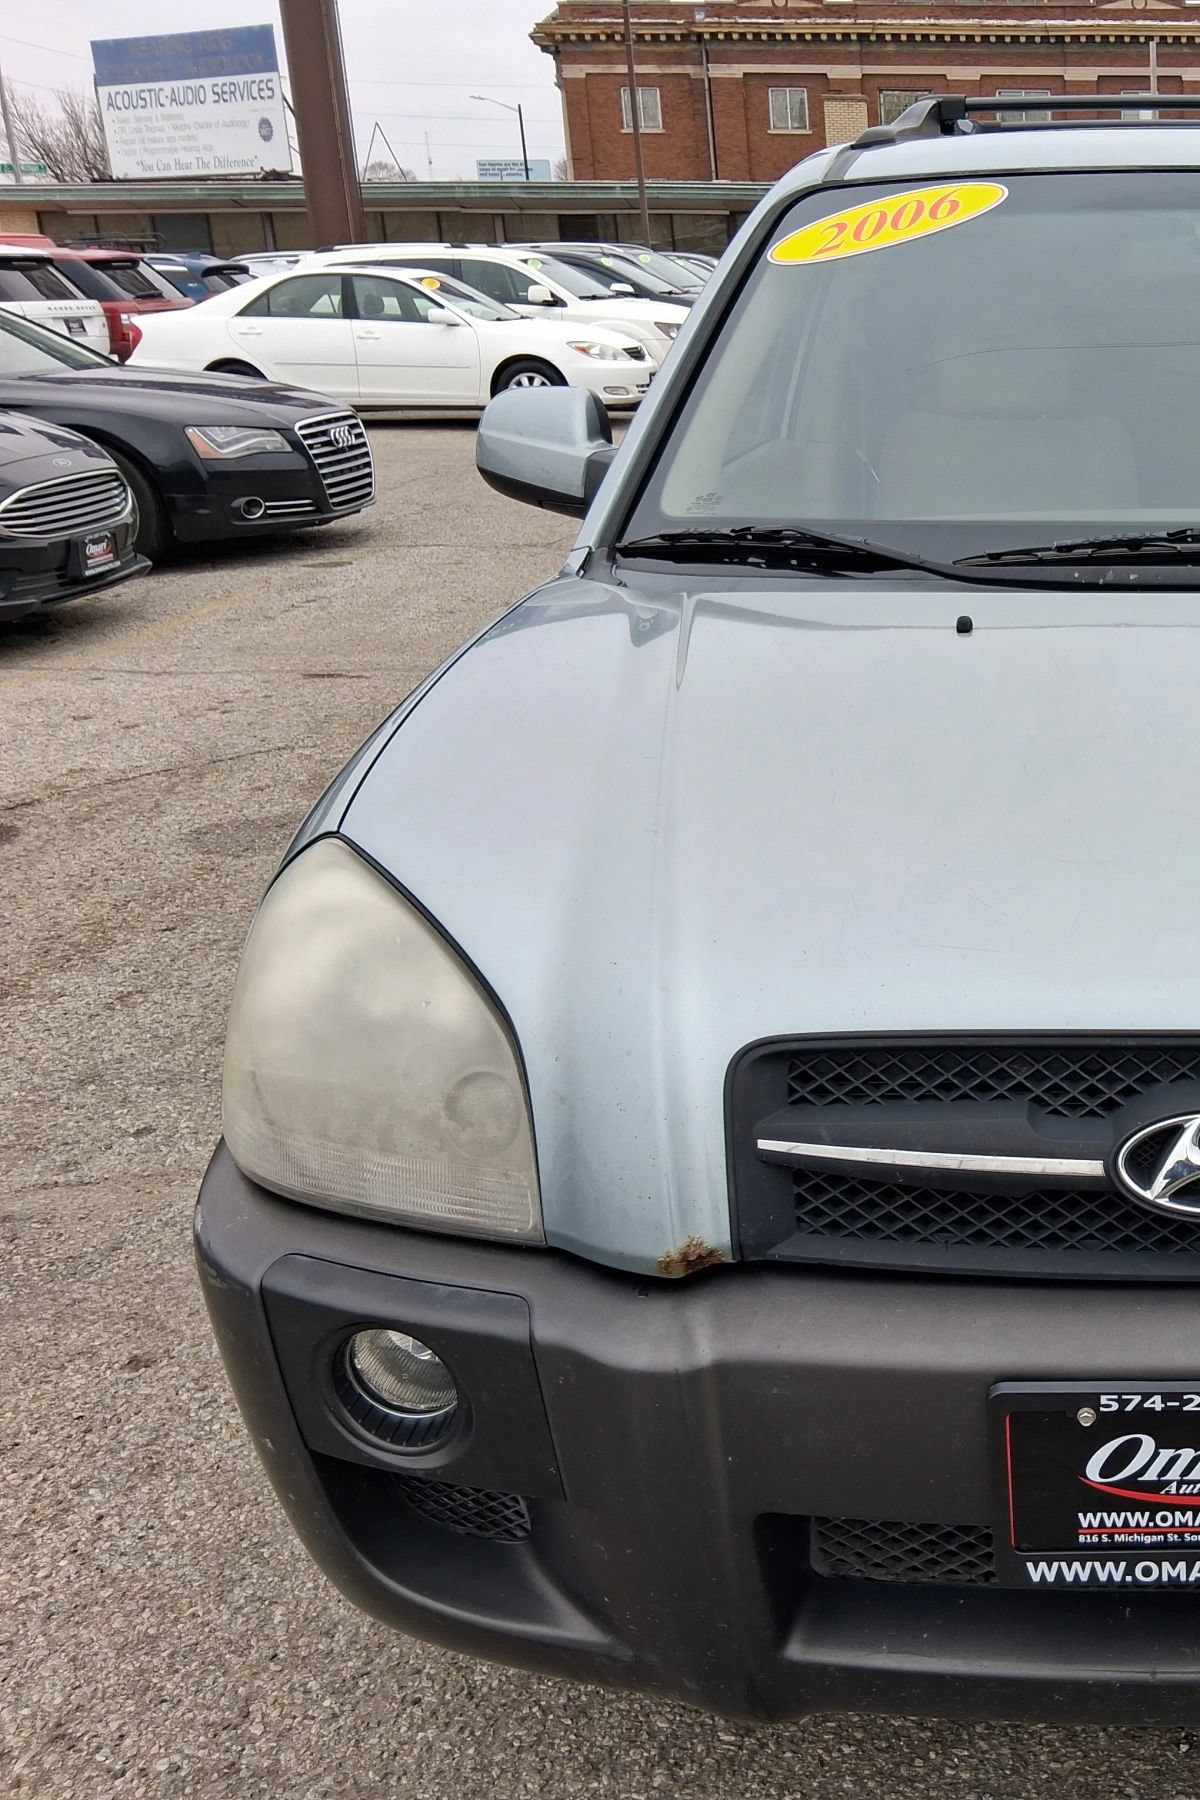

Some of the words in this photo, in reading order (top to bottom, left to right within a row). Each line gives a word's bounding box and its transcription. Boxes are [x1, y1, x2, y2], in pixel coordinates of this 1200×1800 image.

[211, 78, 275, 103] SERVICES
[156, 160, 171, 171] Can
[174, 158, 192, 171] Hear
[195, 157, 211, 170] The
[811, 187, 965, 257] 2006
[1078, 1534, 1099, 1543] 816
[1101, 1534, 1111, 1543] S.
[1114, 1533, 1164, 1544] Michigan
[1167, 1533, 1181, 1542] St.
